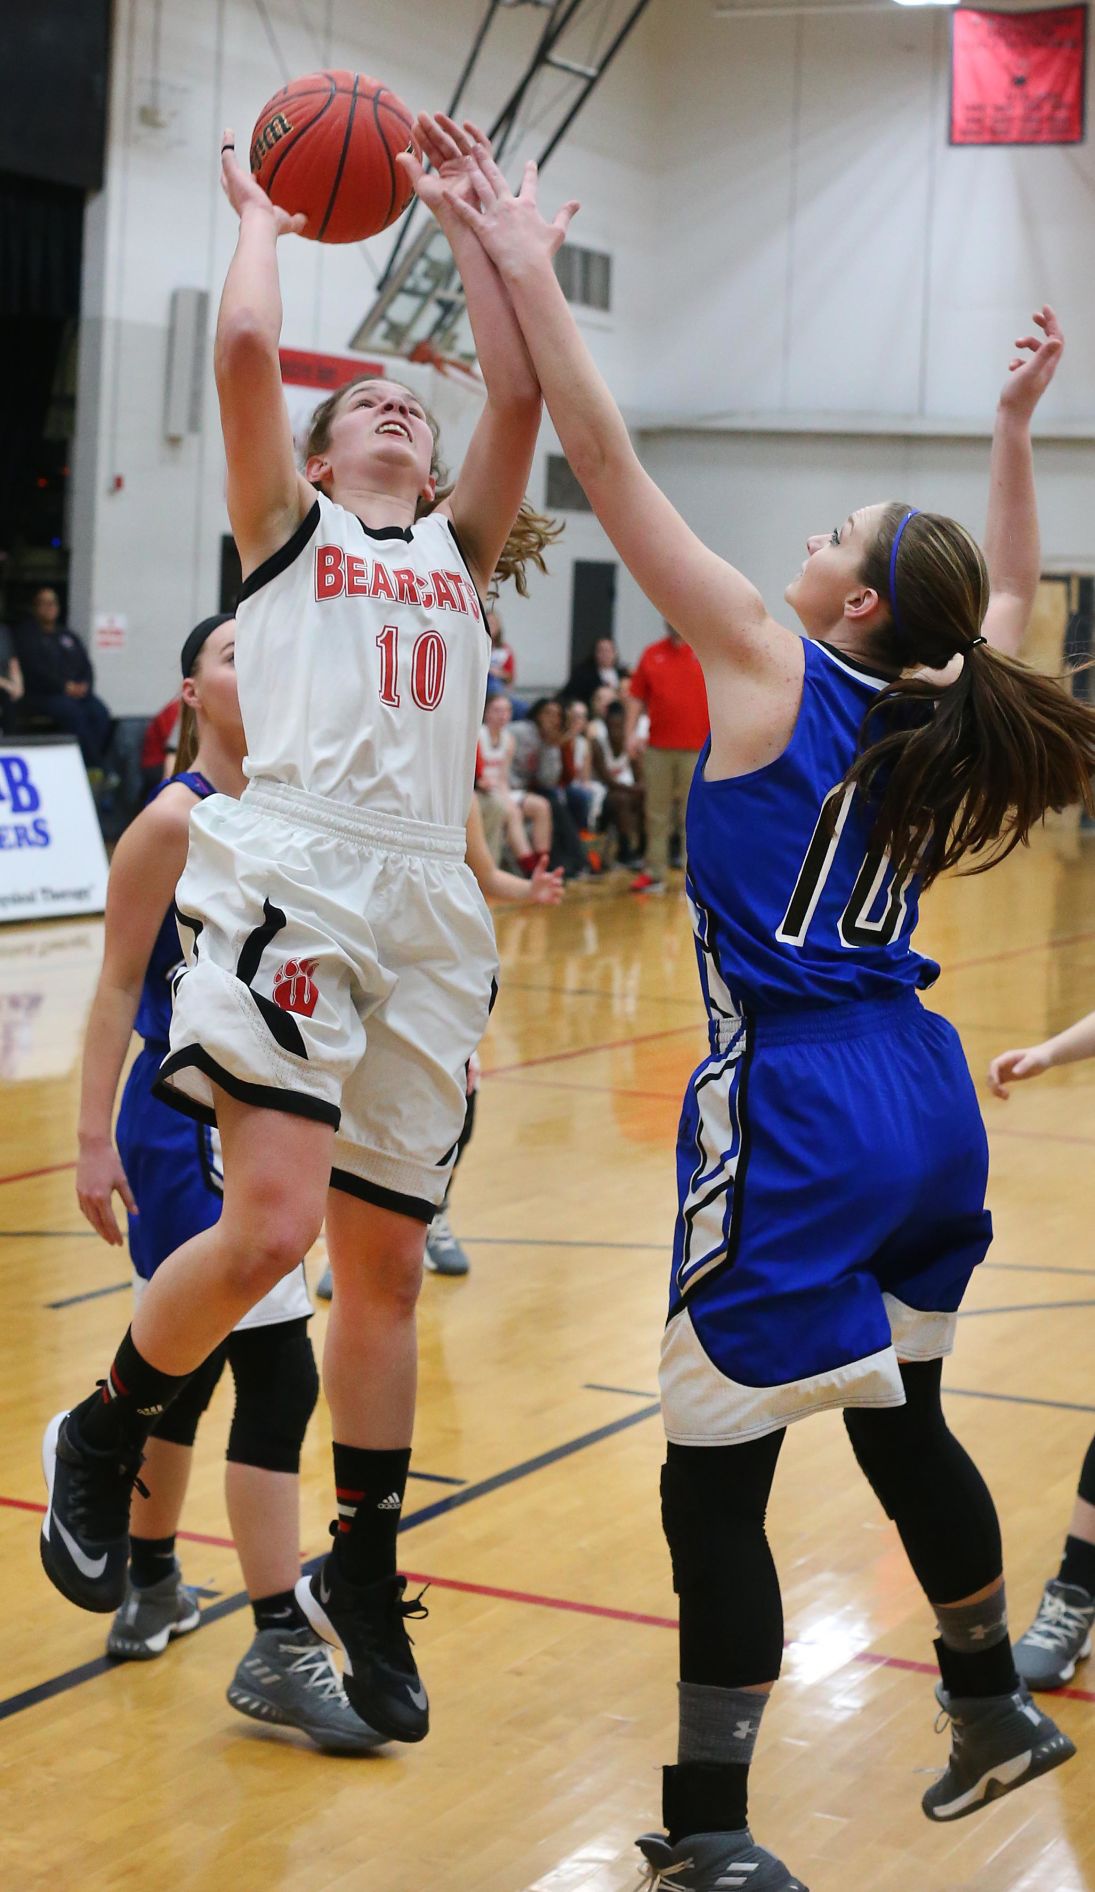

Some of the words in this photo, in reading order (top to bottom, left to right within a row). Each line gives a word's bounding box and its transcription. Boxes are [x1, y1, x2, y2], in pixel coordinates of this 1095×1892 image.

[315, 544, 480, 624] BEARCATS
[376, 625, 447, 712] 10
[775, 781, 934, 949] 10
